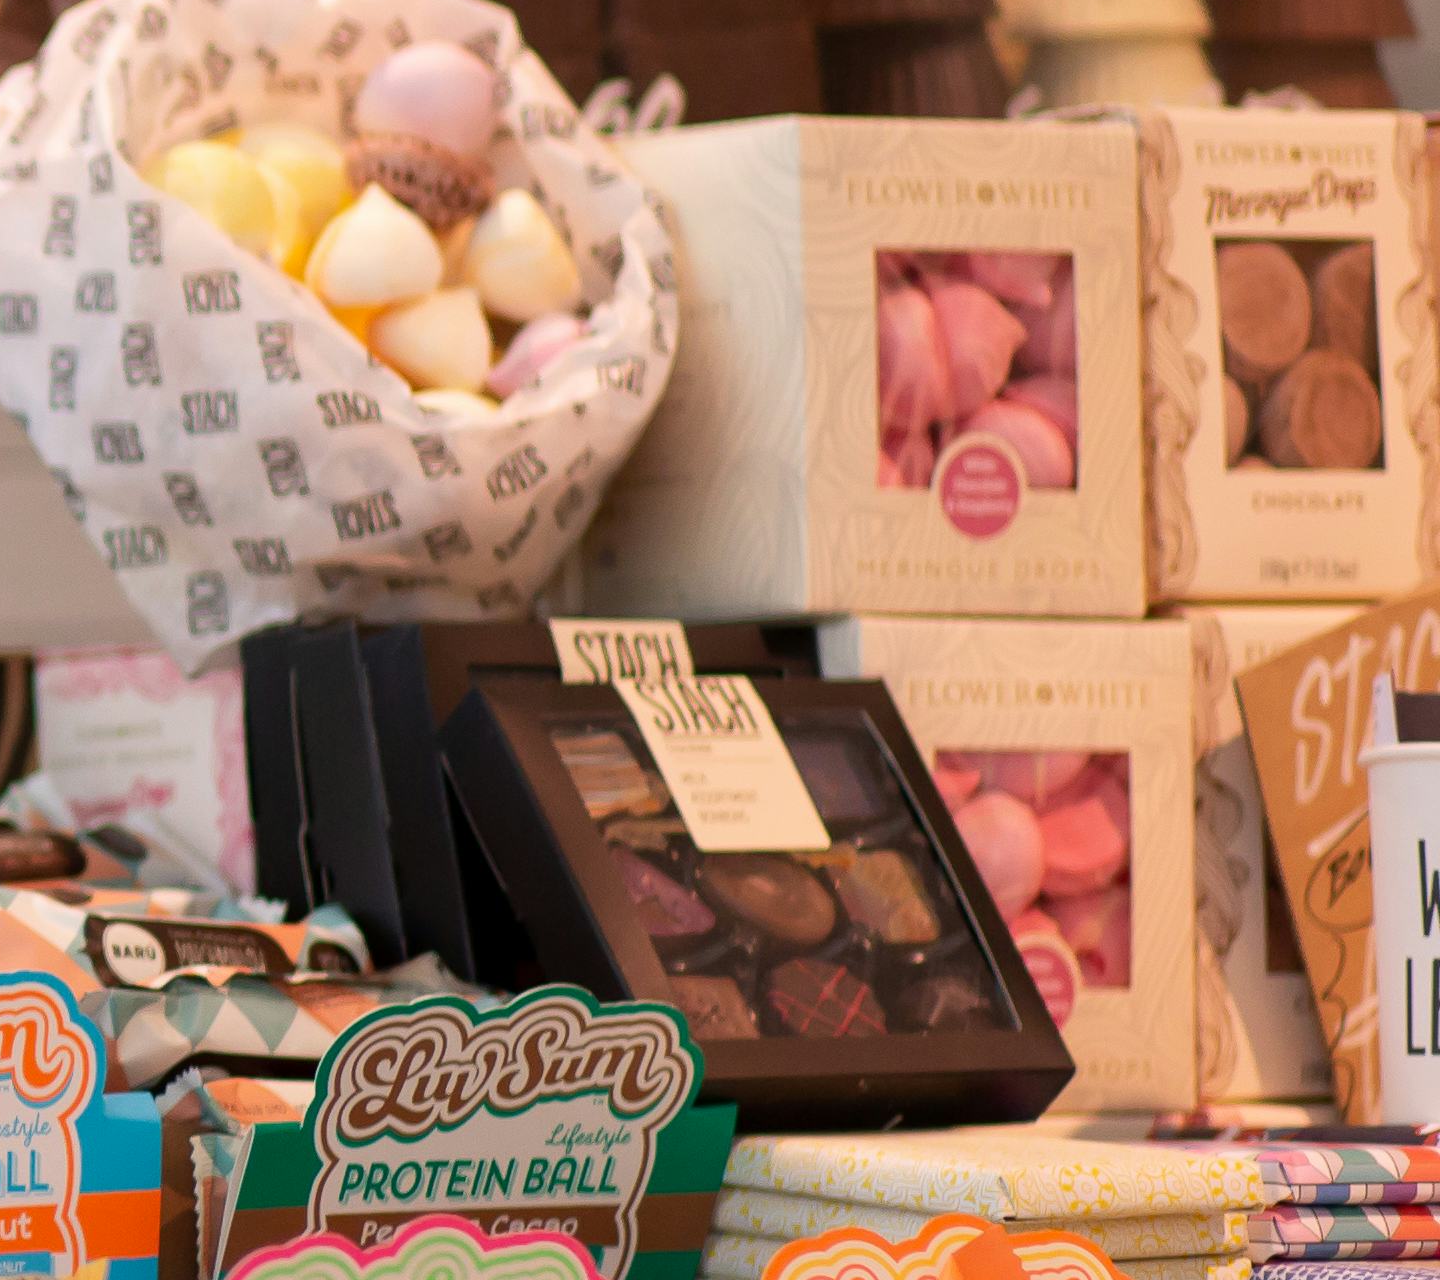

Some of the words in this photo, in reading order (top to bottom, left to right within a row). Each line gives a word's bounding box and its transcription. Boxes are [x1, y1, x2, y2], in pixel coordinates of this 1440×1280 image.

[573, 630, 682, 684] STACH
[634, 676, 761, 737] STACH
[544, 1121, 633, 1158] Lifestyle
[338, 1157, 517, 1205] PROTEIN
[523, 1155, 620, 1196] BALL
